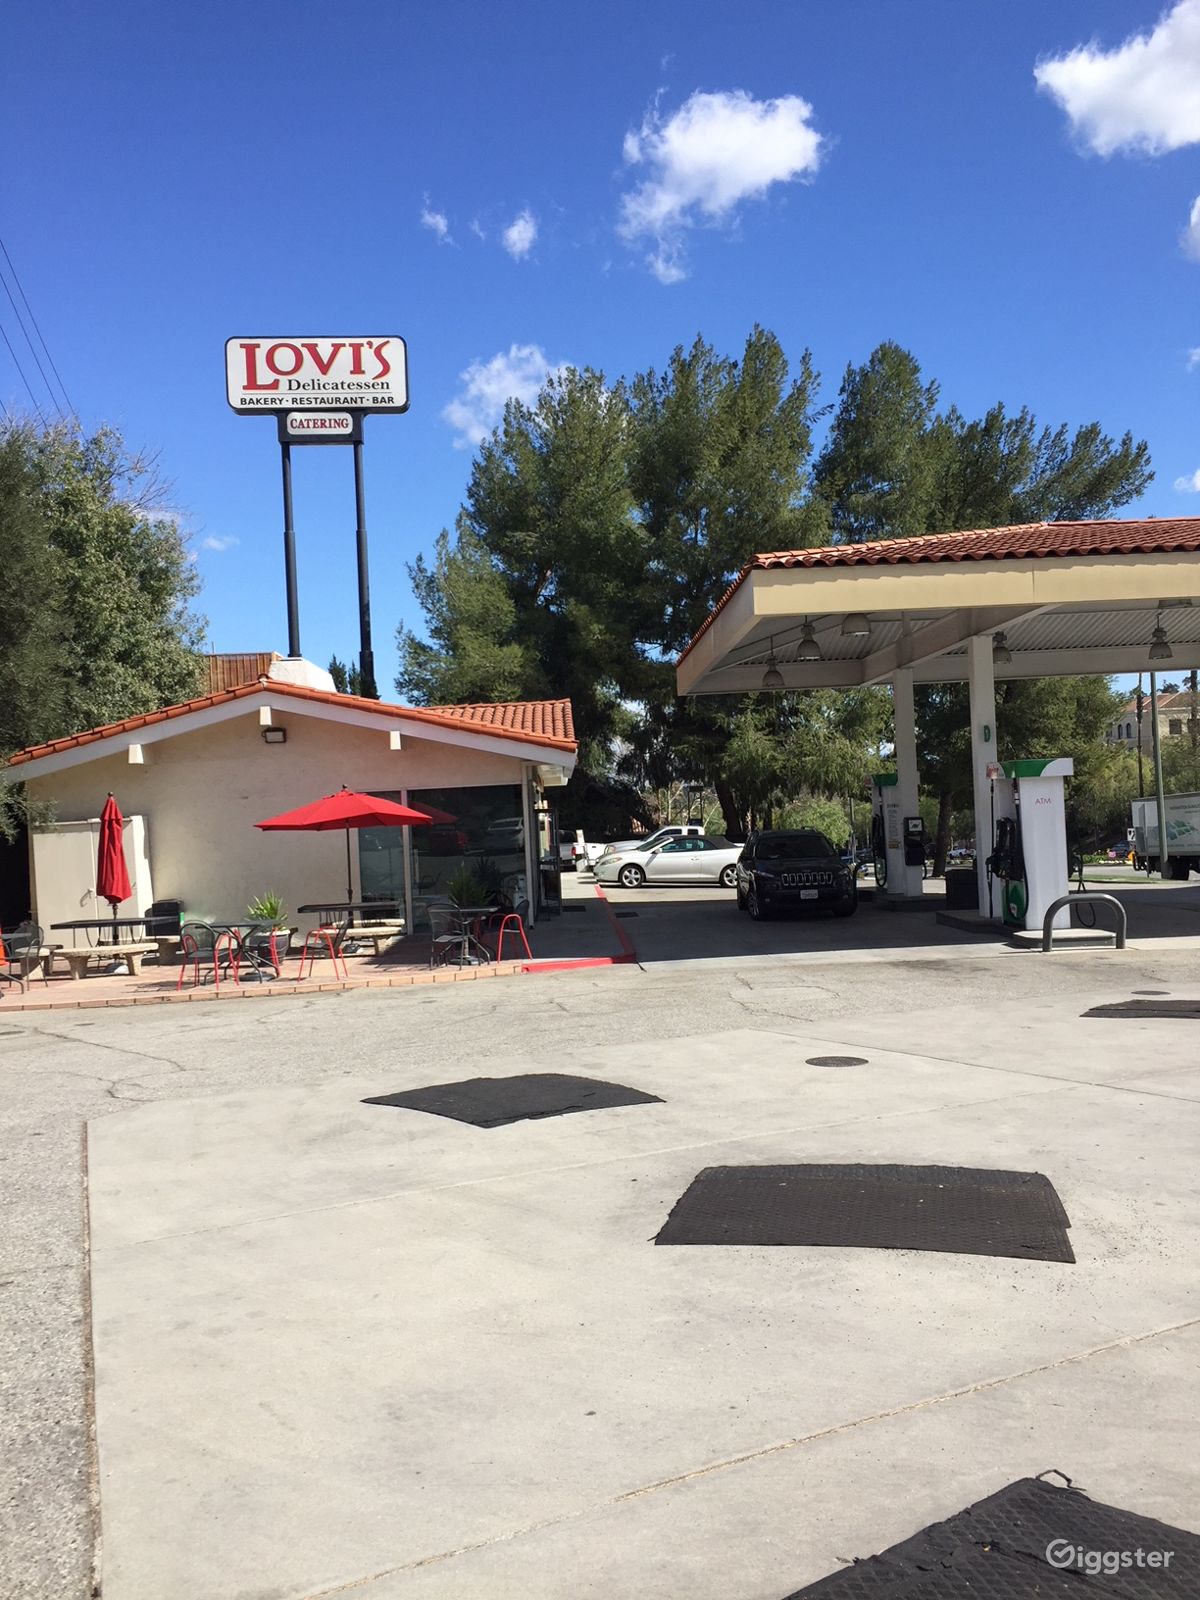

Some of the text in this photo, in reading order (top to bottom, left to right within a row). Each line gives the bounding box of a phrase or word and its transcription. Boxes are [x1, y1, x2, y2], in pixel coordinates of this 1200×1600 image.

[239, 340, 391, 391] LOVI'S
[287, 378, 390, 391] Delicatessen
[240, 396, 395, 406] BAKERY RESTAURANT BAR
[290, 418, 349, 429] CATERING
[983, 725, 991, 743] D
[1034, 797, 1052, 806] ATM
